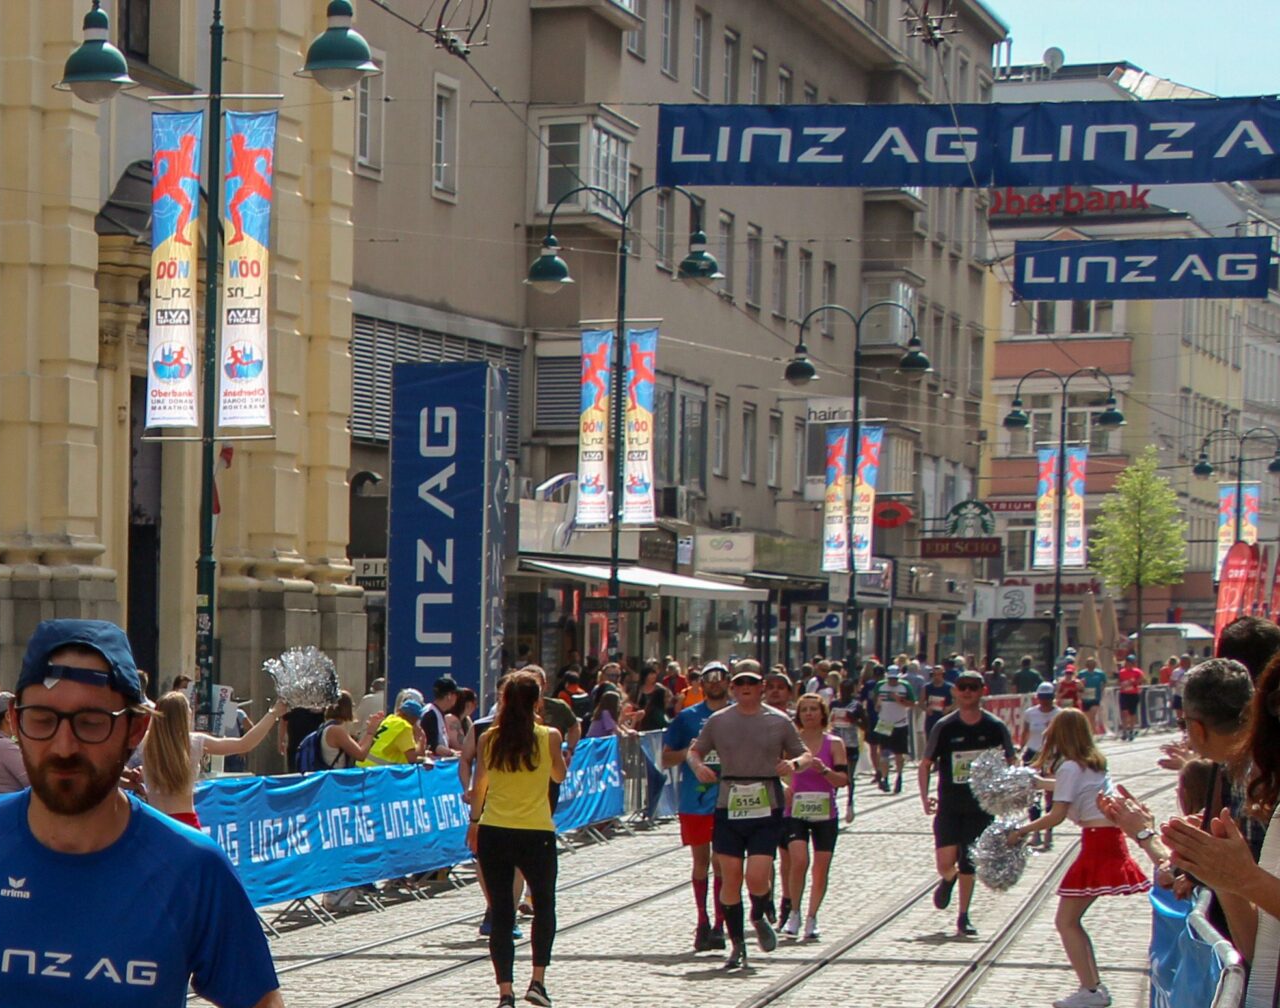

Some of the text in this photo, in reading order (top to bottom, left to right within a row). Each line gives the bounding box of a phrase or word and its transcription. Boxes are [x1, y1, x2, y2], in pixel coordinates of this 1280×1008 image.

[671, 125, 978, 163] LINZ AG
[1009, 121, 1197, 163] LINZ
[1023, 253, 1257, 283] LINZ AG
[158, 311, 188, 320] LIVA
[151, 389, 193, 398] Oberbank
[415, 406, 457, 679] INZ AG
[926, 542, 997, 555] EDUSCHO
[432, 794, 460, 831] LINZ
[736, 797, 761, 807] 5154
[317, 805, 375, 849] LINZ AG
[380, 798, 430, 840] LINZ AG
[249, 814, 311, 864] LINZ AG
[0, 888, 30, 899] erima
[84, 958, 158, 986] AG
